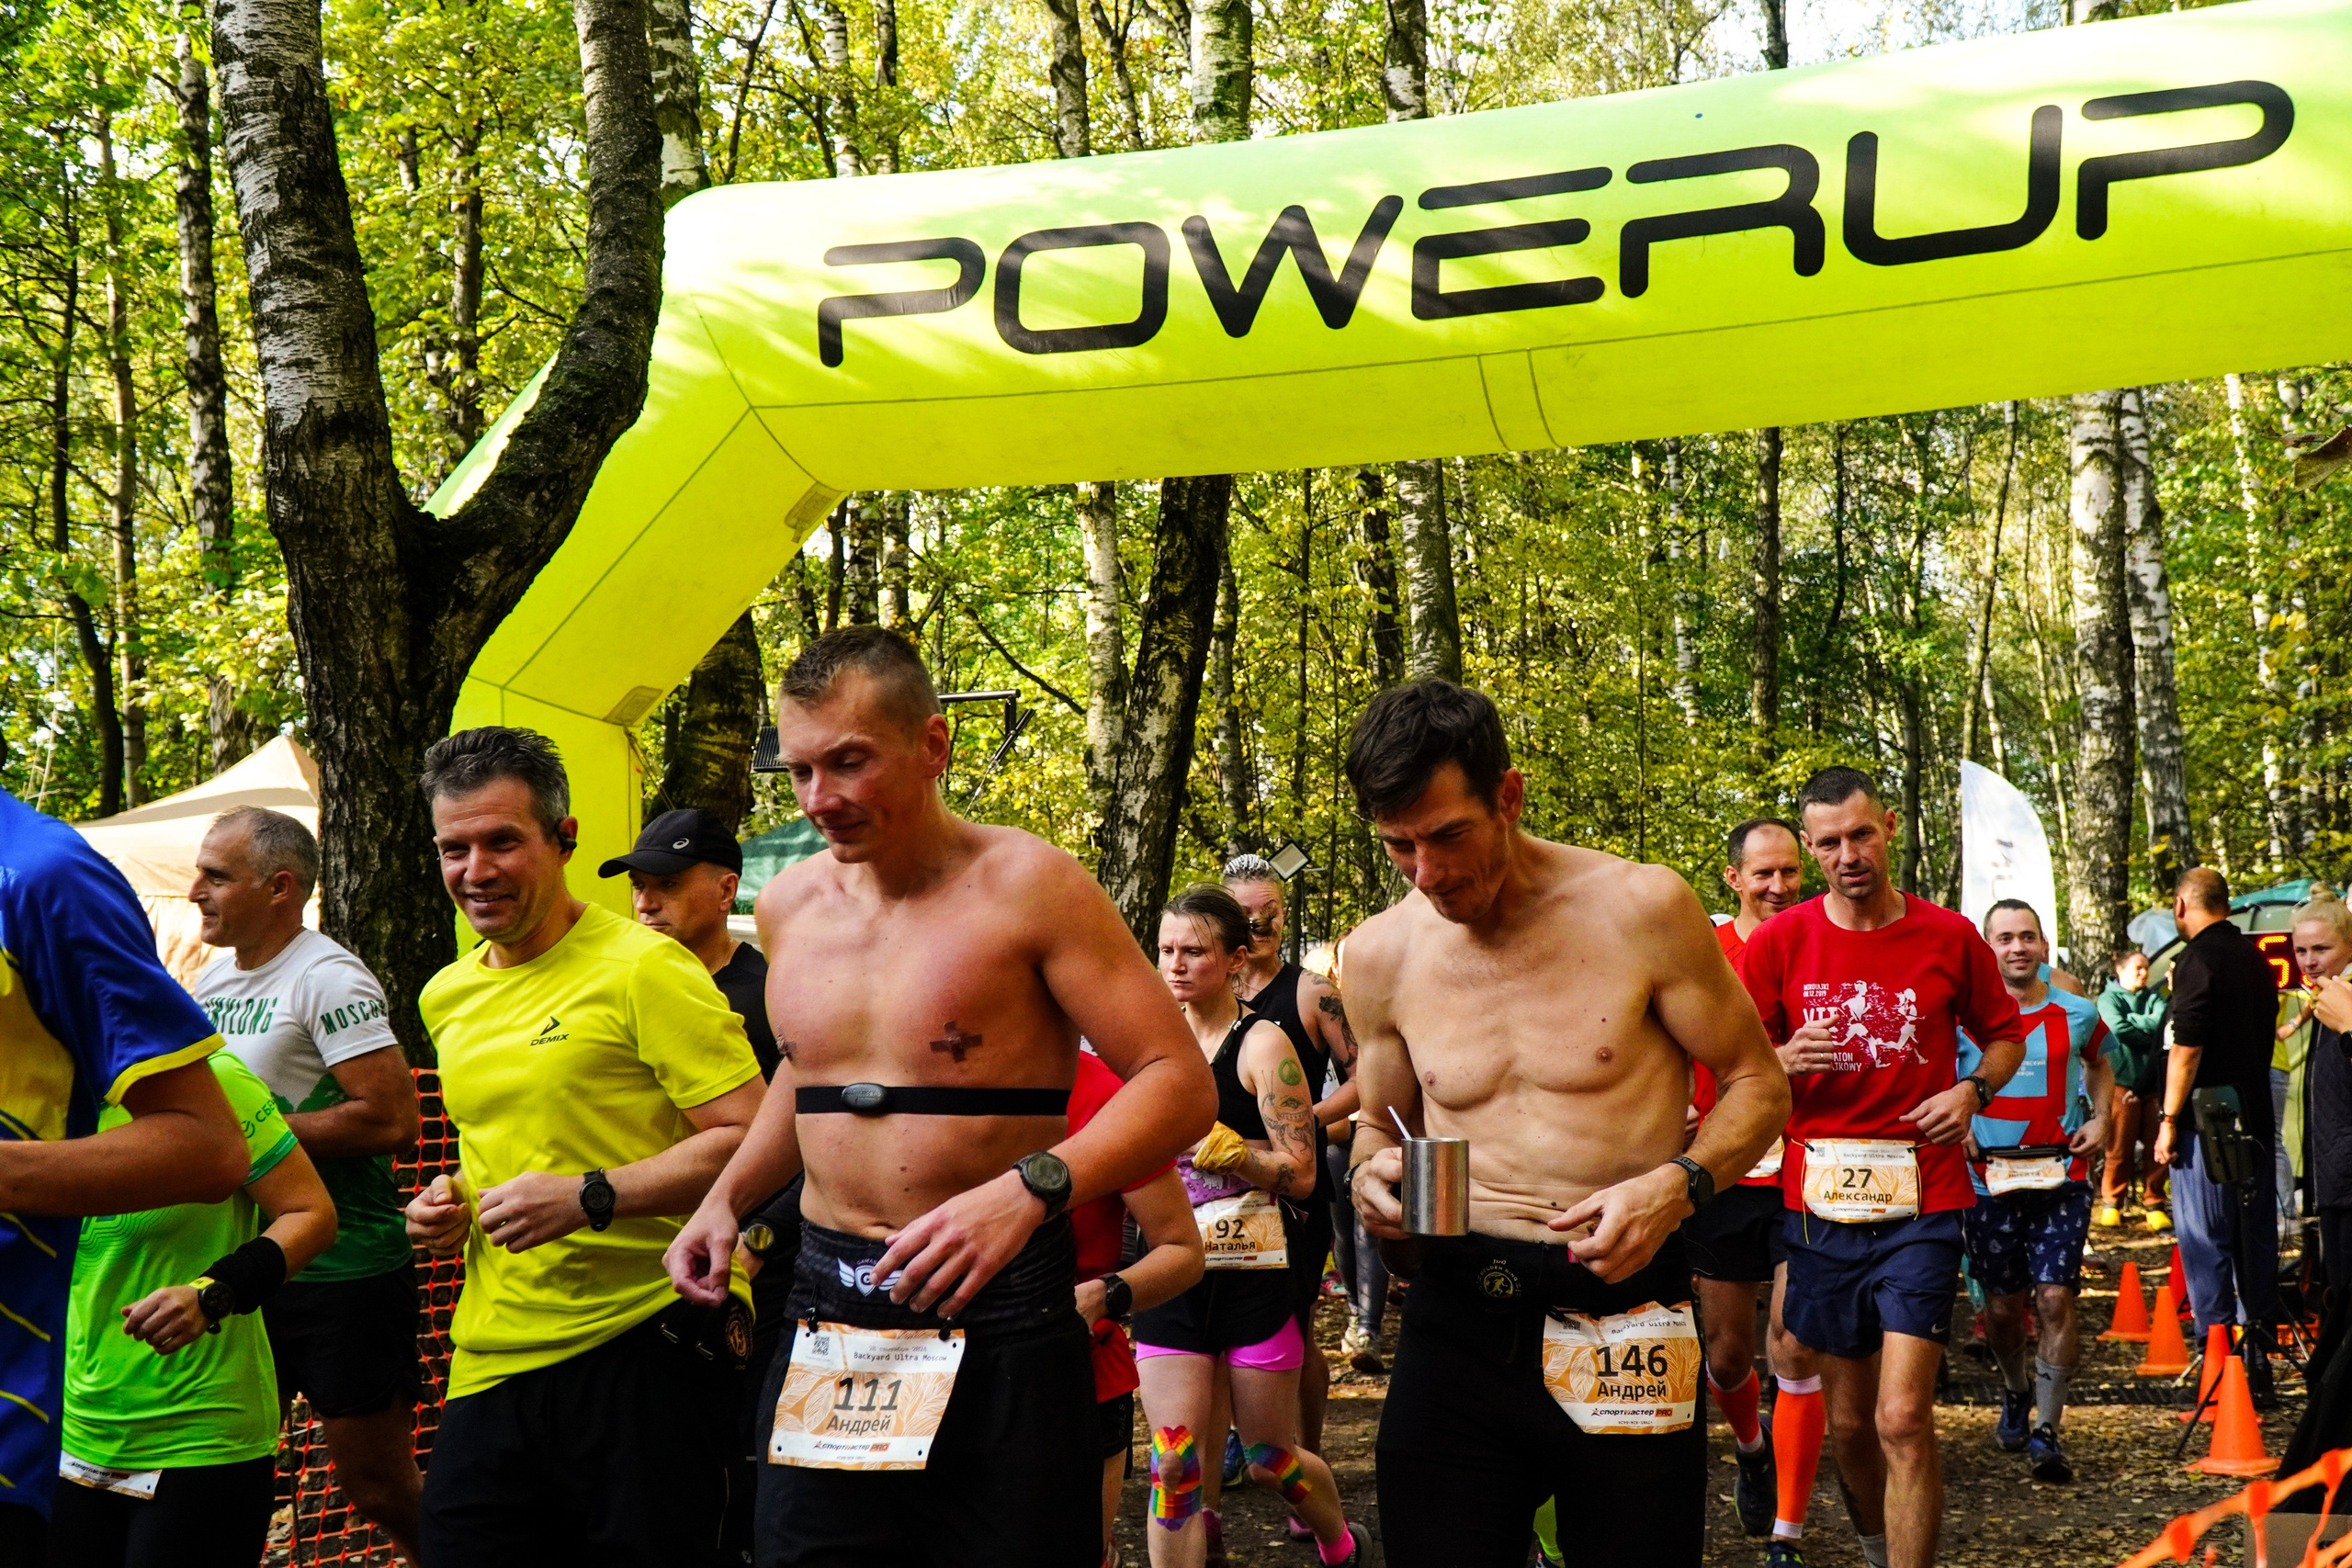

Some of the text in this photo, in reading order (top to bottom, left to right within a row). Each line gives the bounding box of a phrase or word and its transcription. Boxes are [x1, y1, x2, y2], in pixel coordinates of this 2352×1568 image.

[818, 80, 2295, 367] POWERUP
[530, 1033, 570, 1046] DEMIX
[1842, 1168, 1872, 1188] 27
[1824, 1190, 1893, 1204] Александр
[1216, 1219, 1245, 1238] 92
[1204, 1241, 1256, 1251] Наталья
[854, 1352, 889, 1362] Backyard
[895, 1352, 919, 1361] Ultra
[1596, 1344, 1668, 1377] 146
[834, 1377, 903, 1412] 111
[1597, 1382, 1667, 1401] Андрей
[1656, 1408, 1672, 1416] PRO
[826, 1415, 892, 1437] Андрей
